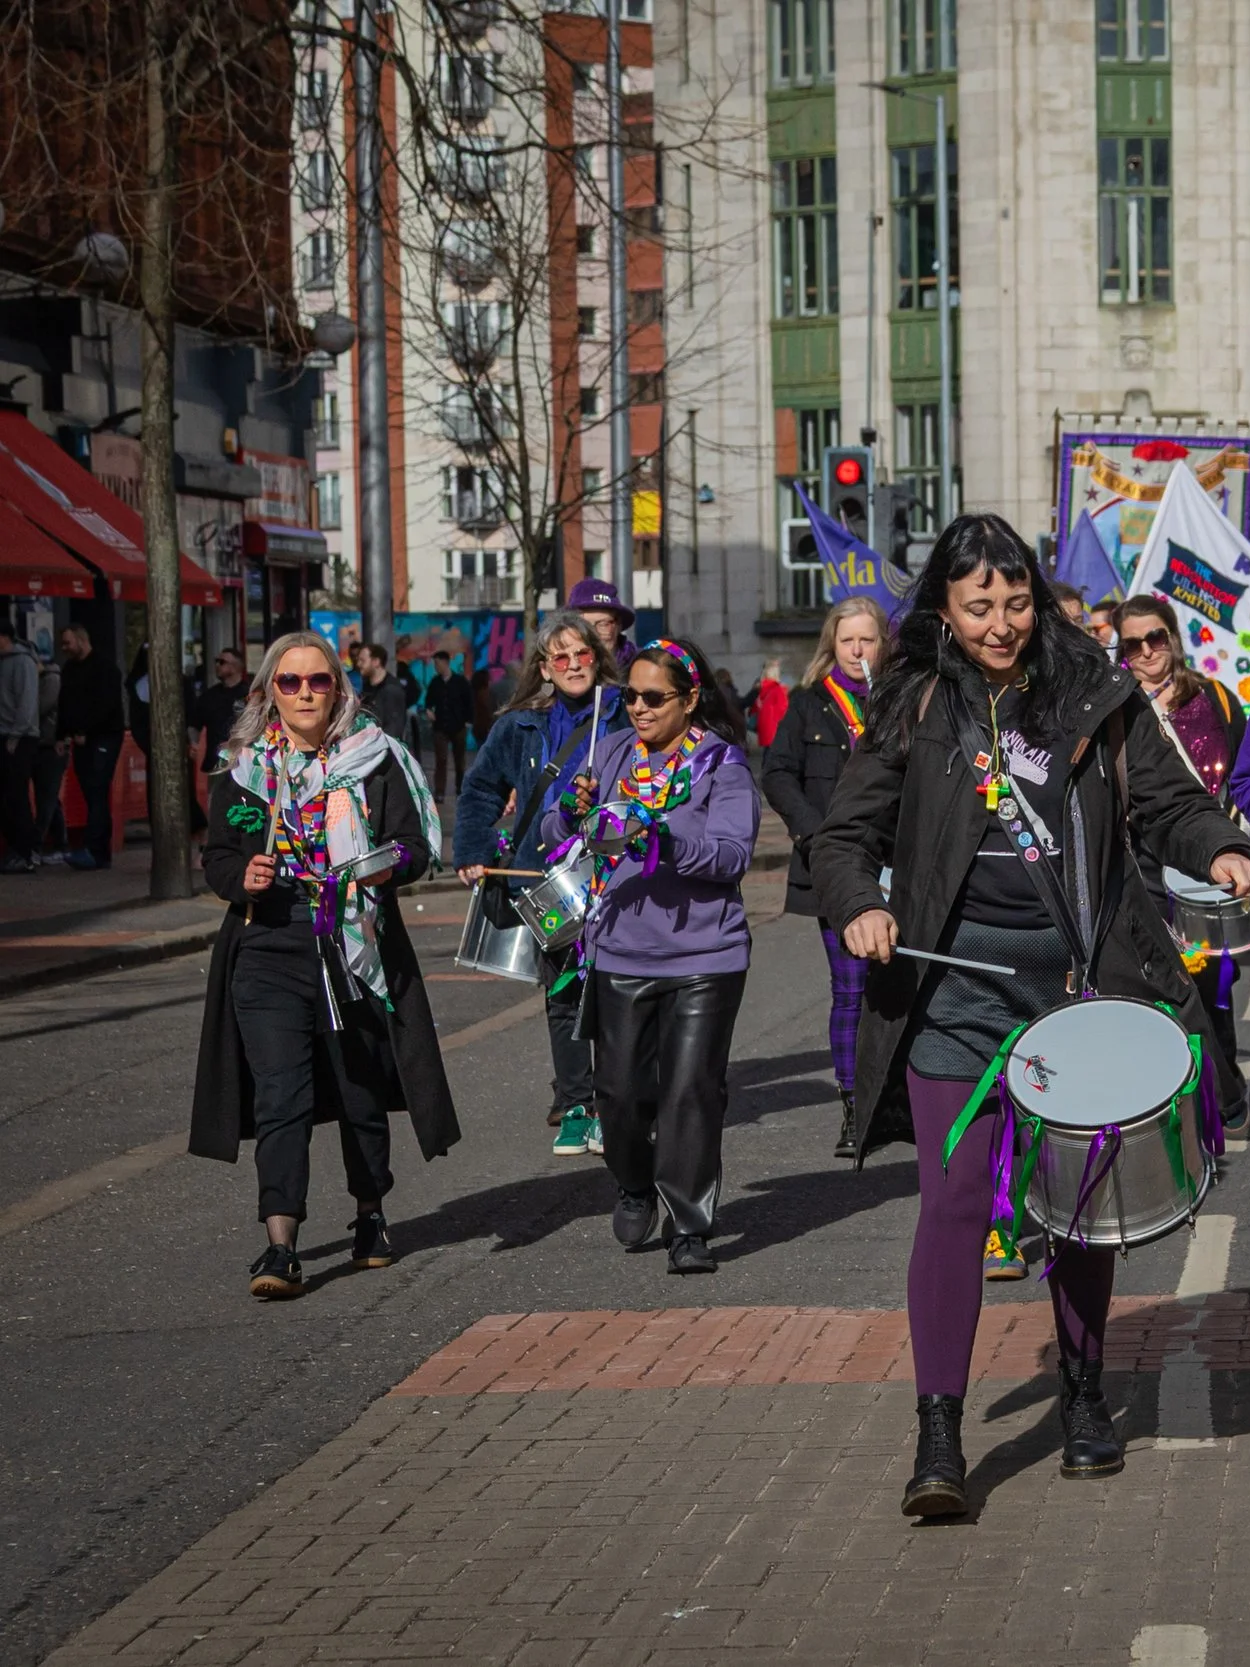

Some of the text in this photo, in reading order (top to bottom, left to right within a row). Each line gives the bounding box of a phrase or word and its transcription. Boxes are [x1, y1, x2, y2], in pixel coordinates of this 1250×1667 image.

[1169, 557, 1238, 607] REVOLUTION
[1194, 560, 1214, 582] THE
[1172, 573, 1198, 594] WILL
[1198, 586, 1223, 610] NOT
[1172, 586, 1221, 622] KNITTED
